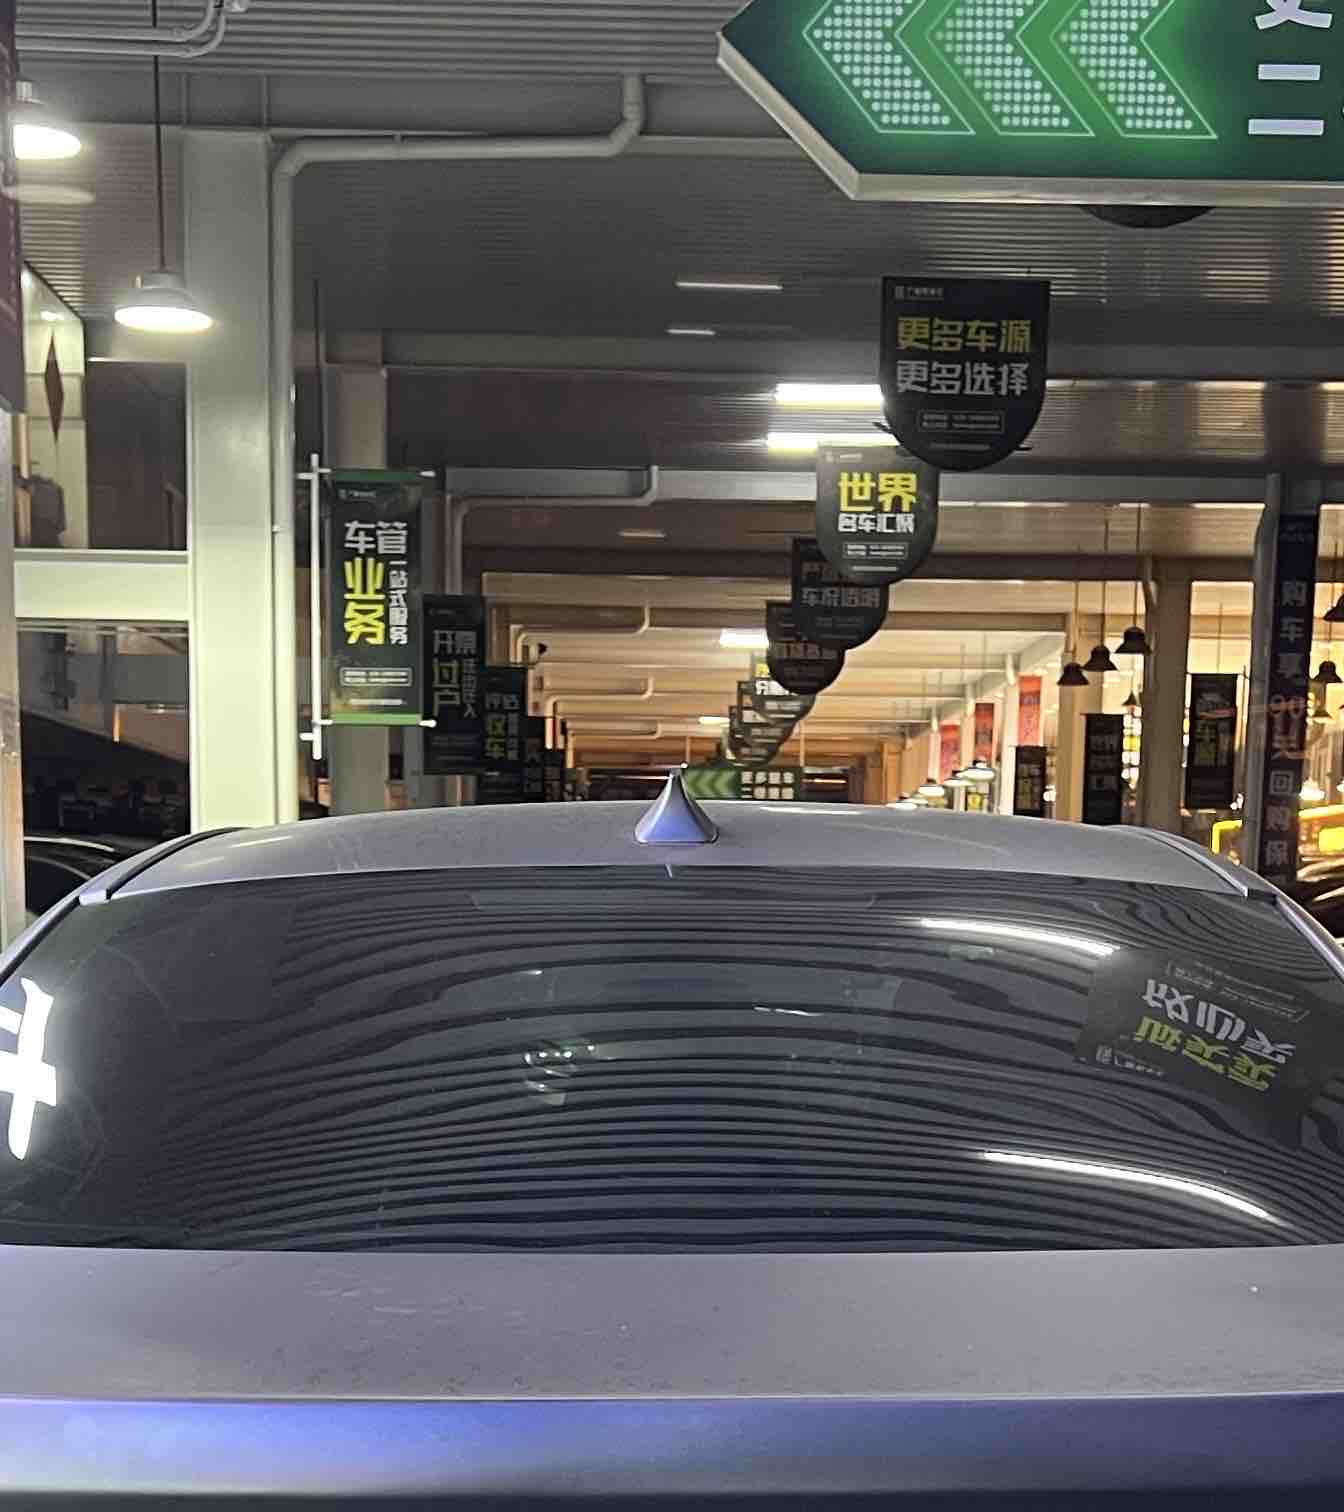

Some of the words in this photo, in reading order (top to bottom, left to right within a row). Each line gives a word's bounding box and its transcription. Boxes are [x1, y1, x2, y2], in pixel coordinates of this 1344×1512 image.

[896, 315, 1033, 353] 更多车源
[895, 359, 1030, 396] 更多选择
[837, 471, 918, 513] 世界
[343, 519, 409, 555] 车管
[343, 556, 387, 645] 业务
